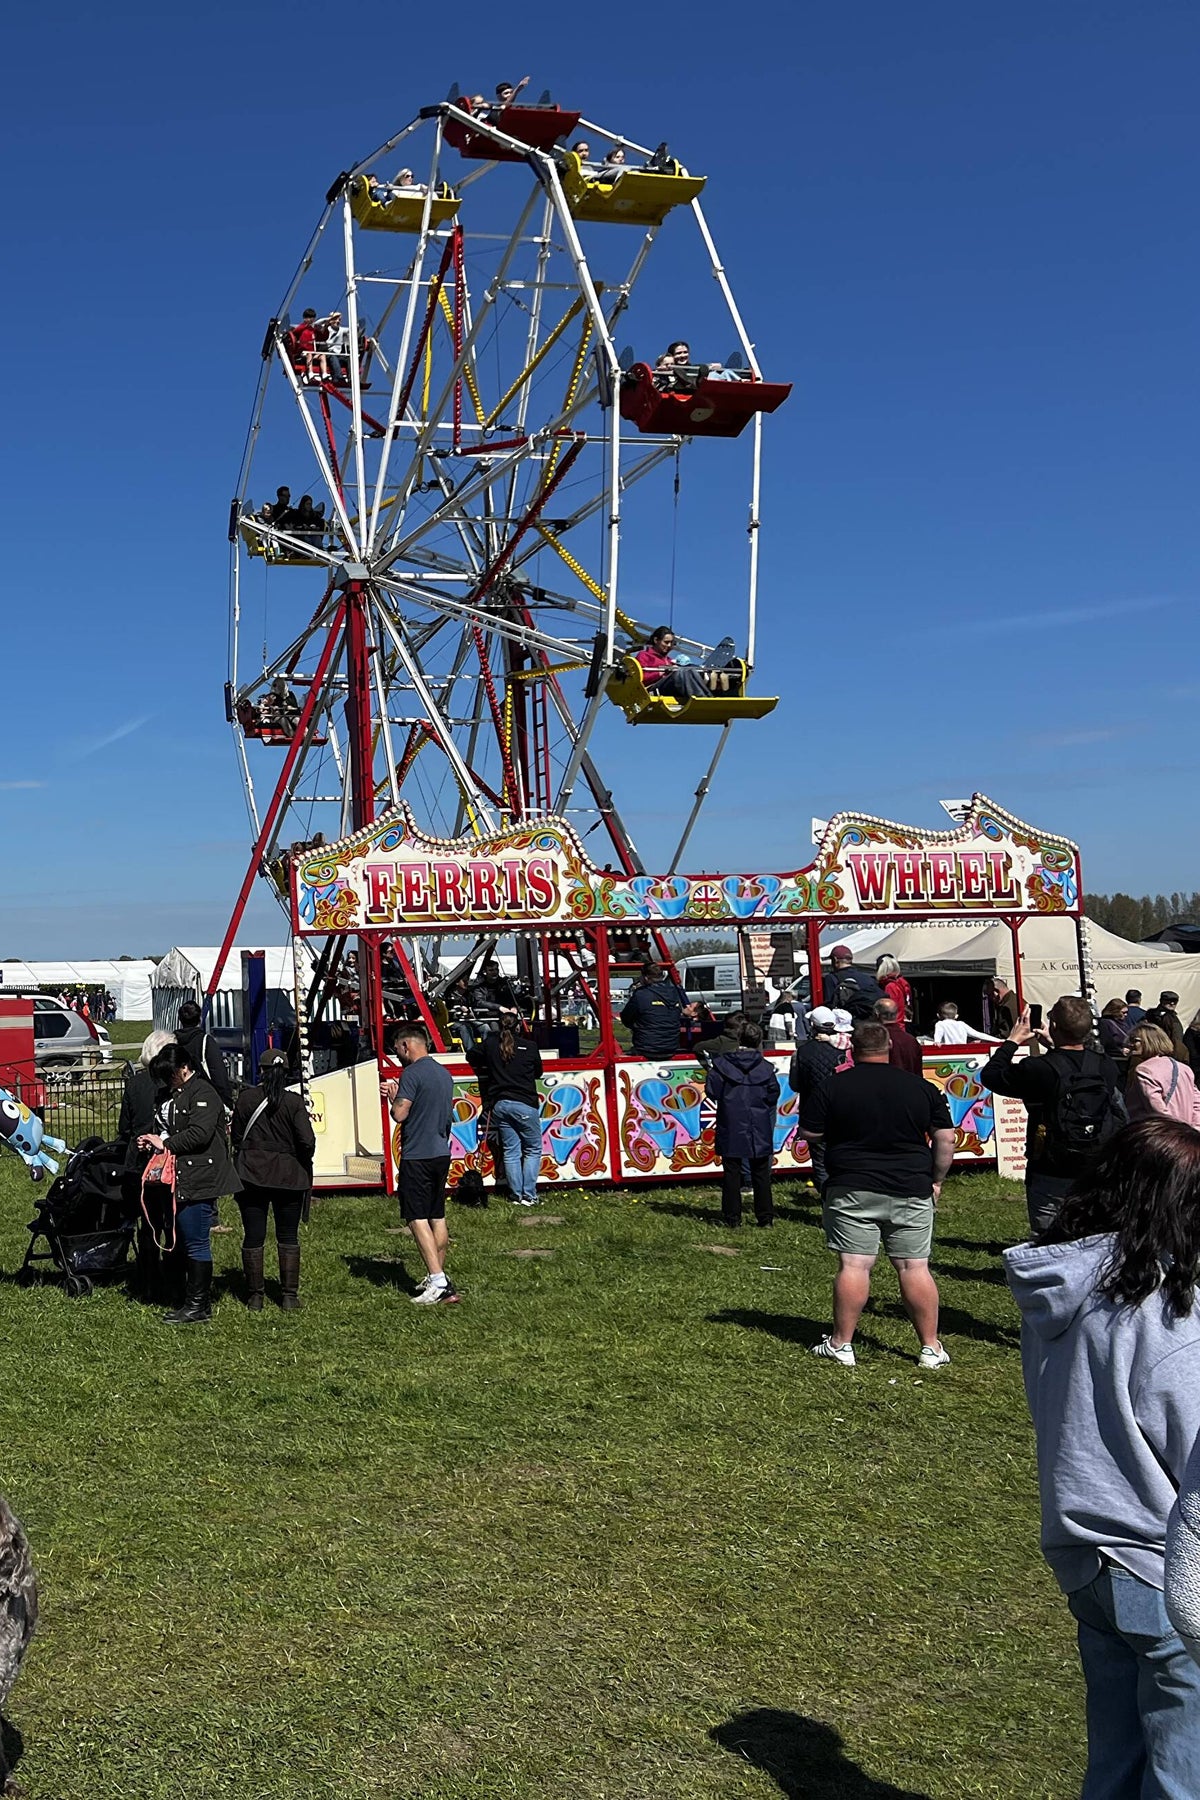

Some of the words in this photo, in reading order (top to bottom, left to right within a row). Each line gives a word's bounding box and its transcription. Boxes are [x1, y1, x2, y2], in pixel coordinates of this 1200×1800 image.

[363, 858, 560, 922] FERRIS
[847, 850, 1022, 910] WHEEL
[1040, 962, 1048, 970] A
[1050, 962, 1057, 970] K
[1096, 962, 1142, 970] Accessories
[1144, 961, 1158, 969] Ltd
